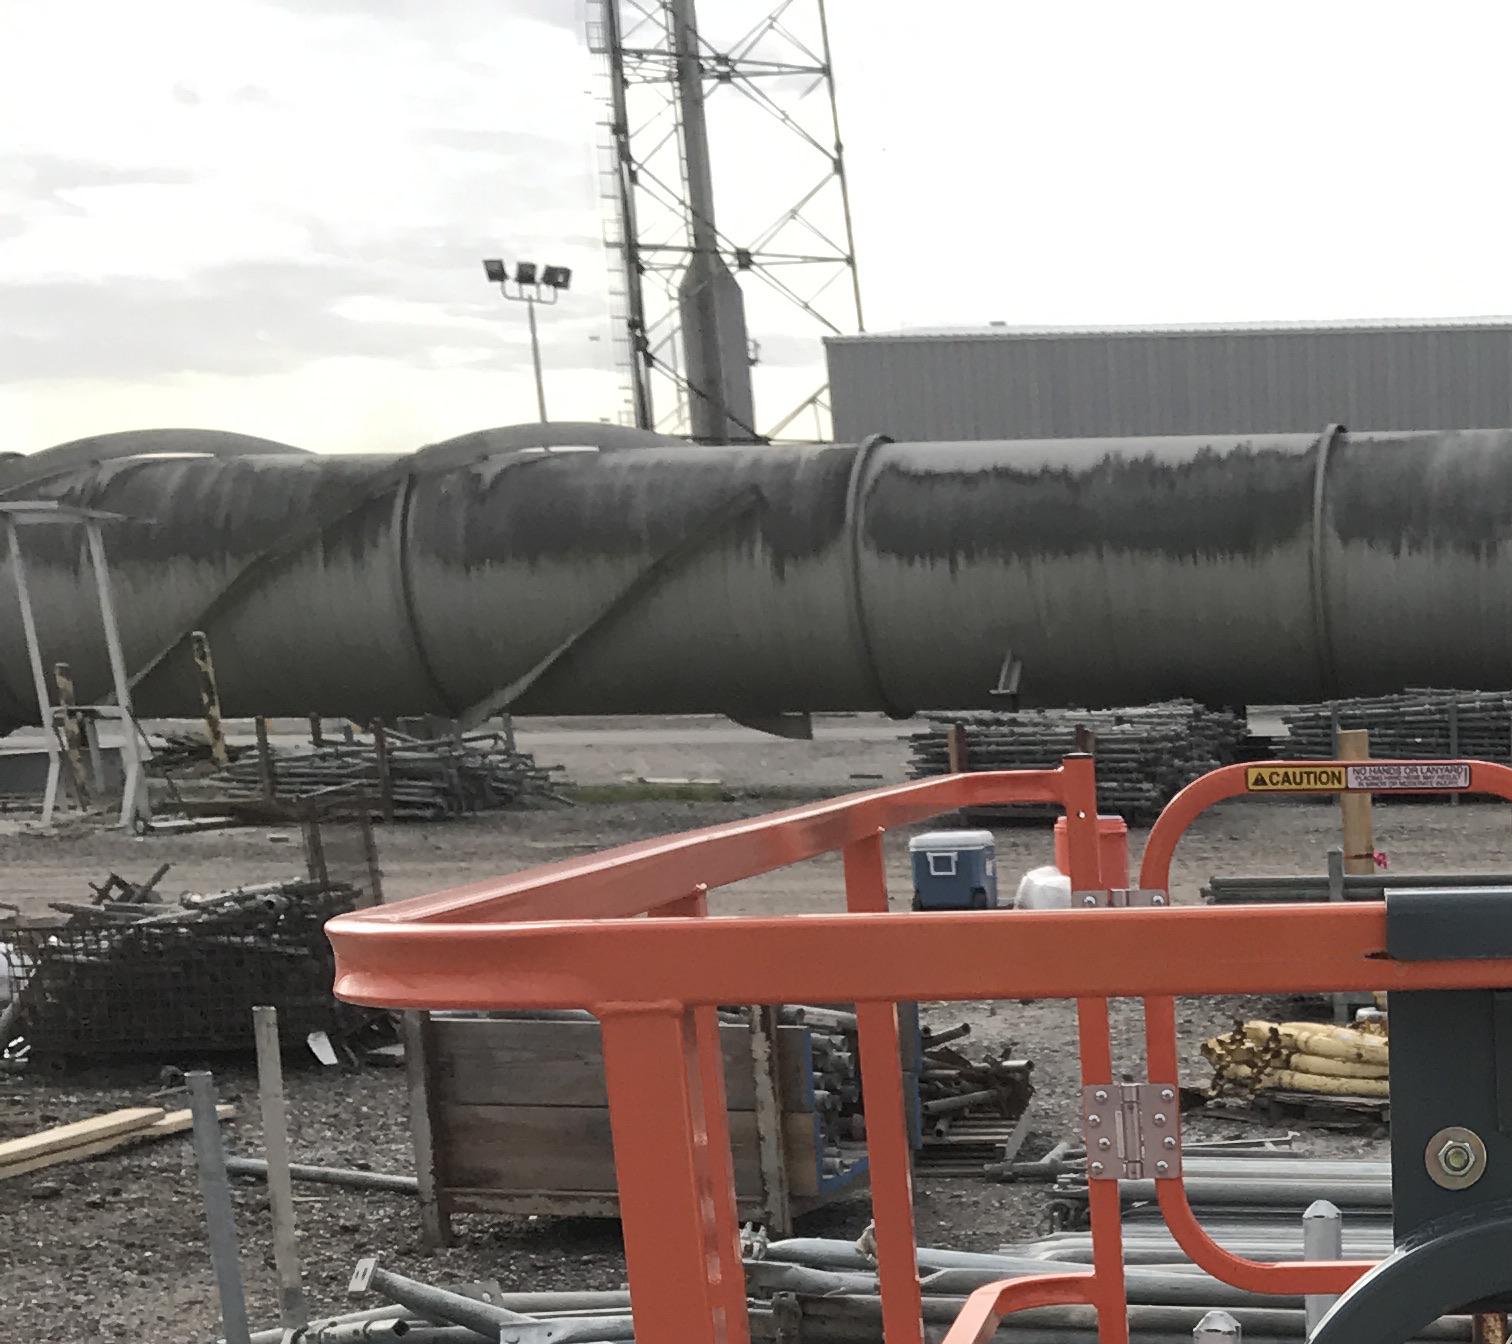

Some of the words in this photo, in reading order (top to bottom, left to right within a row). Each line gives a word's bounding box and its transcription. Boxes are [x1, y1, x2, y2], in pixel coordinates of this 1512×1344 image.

[1353, 767, 1366, 776] NO
[1404, 766, 1419, 775] OR
[1421, 765, 1463, 775] LANYARD
[1269, 771, 1342, 786] CAUTION
